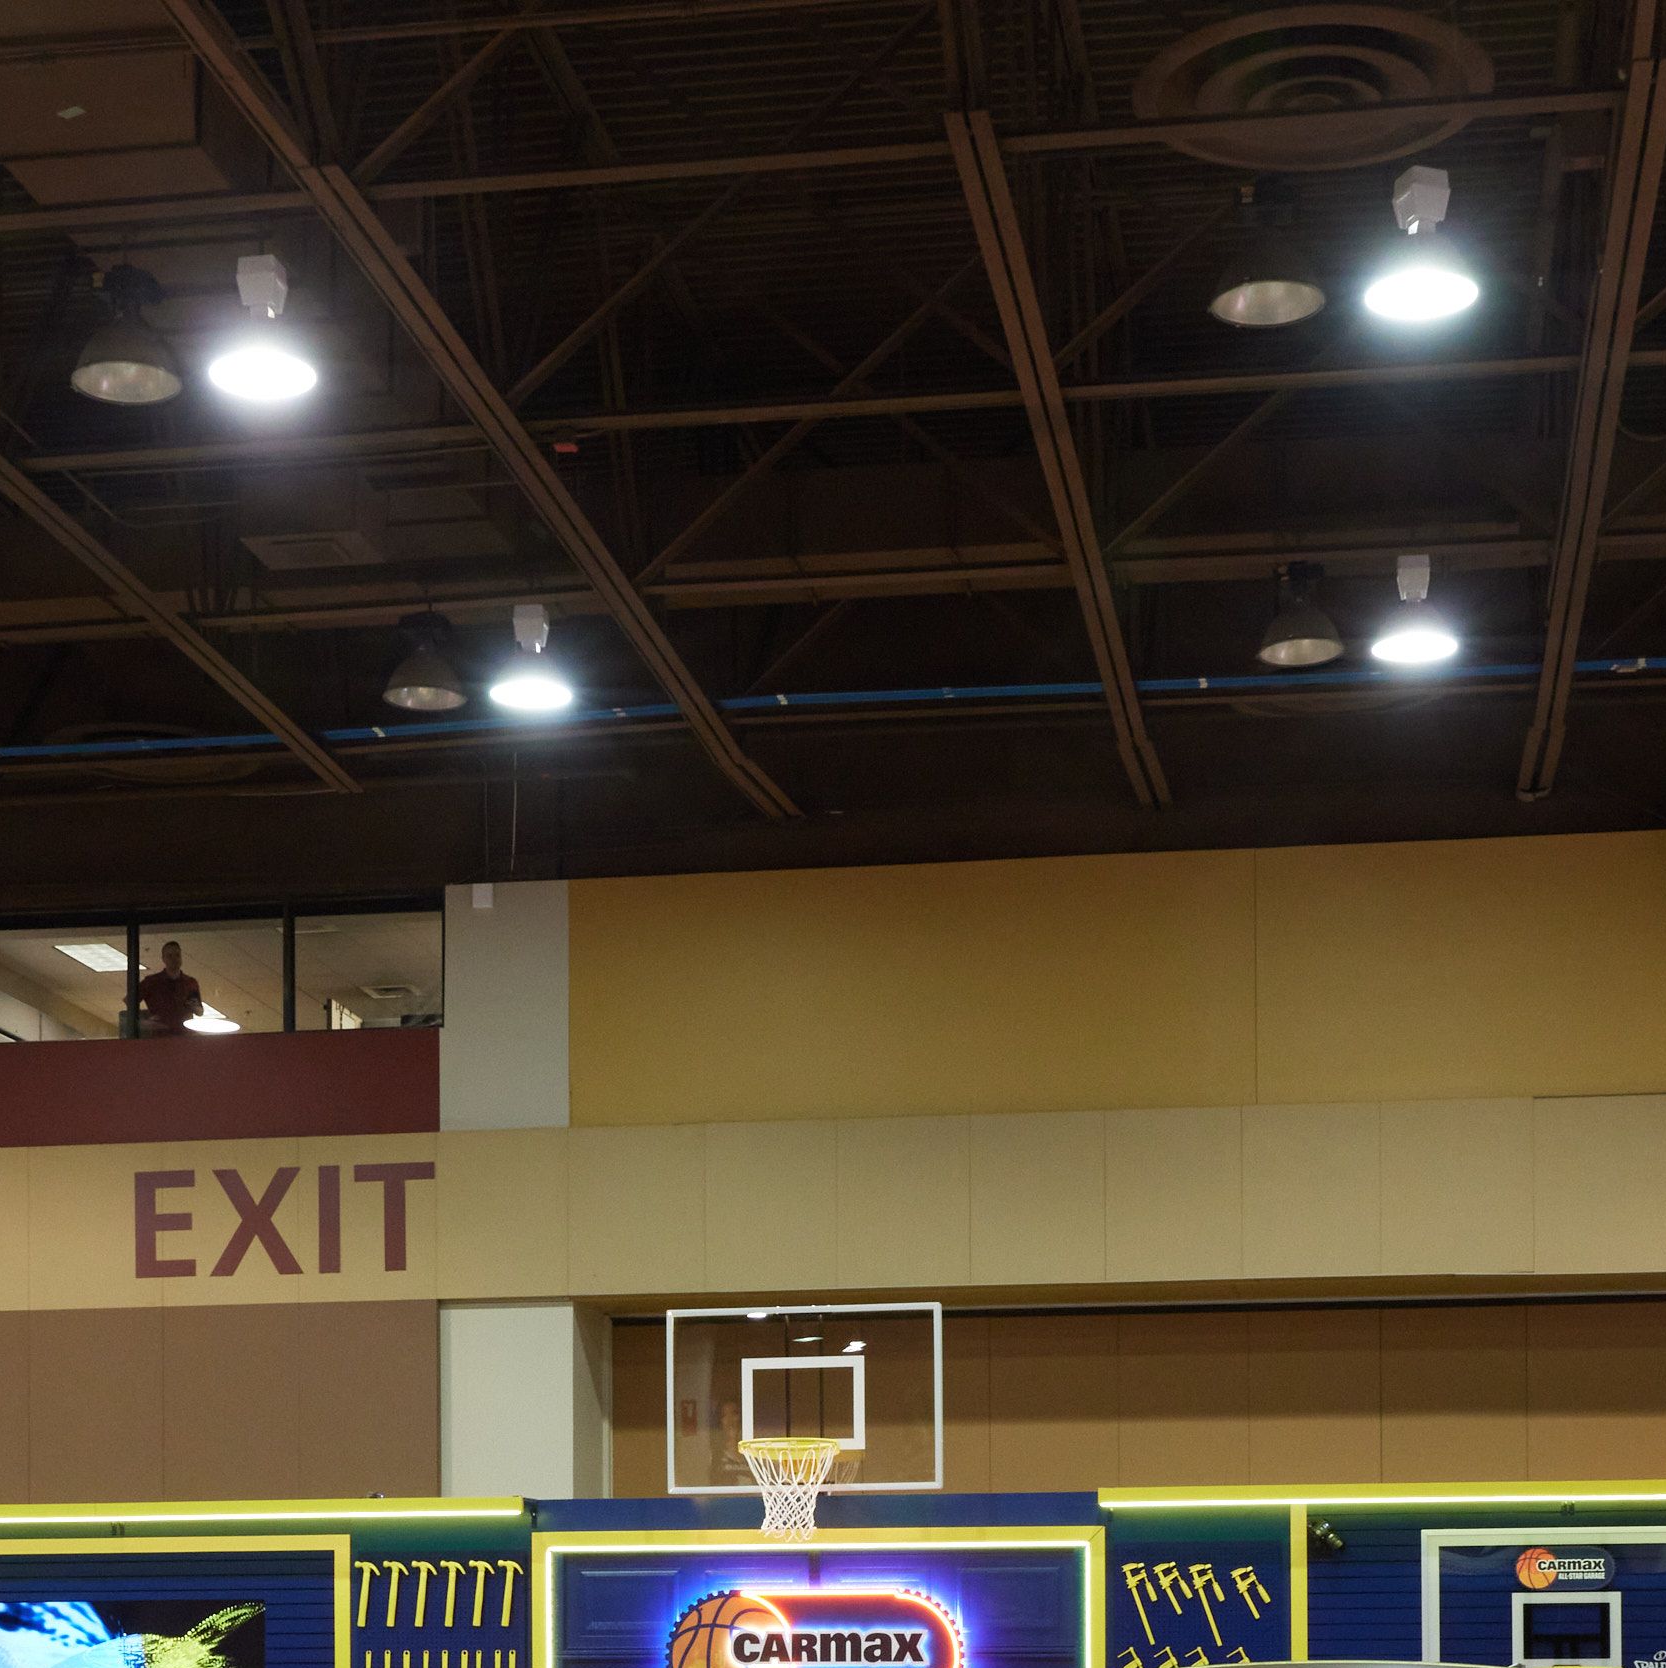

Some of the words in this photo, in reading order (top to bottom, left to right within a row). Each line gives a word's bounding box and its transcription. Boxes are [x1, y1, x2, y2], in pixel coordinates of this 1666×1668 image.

[134, 1161, 435, 1279] EXIT
[1537, 1559, 1605, 1571] CARmax
[1558, 1572, 1583, 1580] ALL-STAR
[1584, 1572, 1606, 1580] GARAGE
[732, 1632, 925, 1663] CARmax
